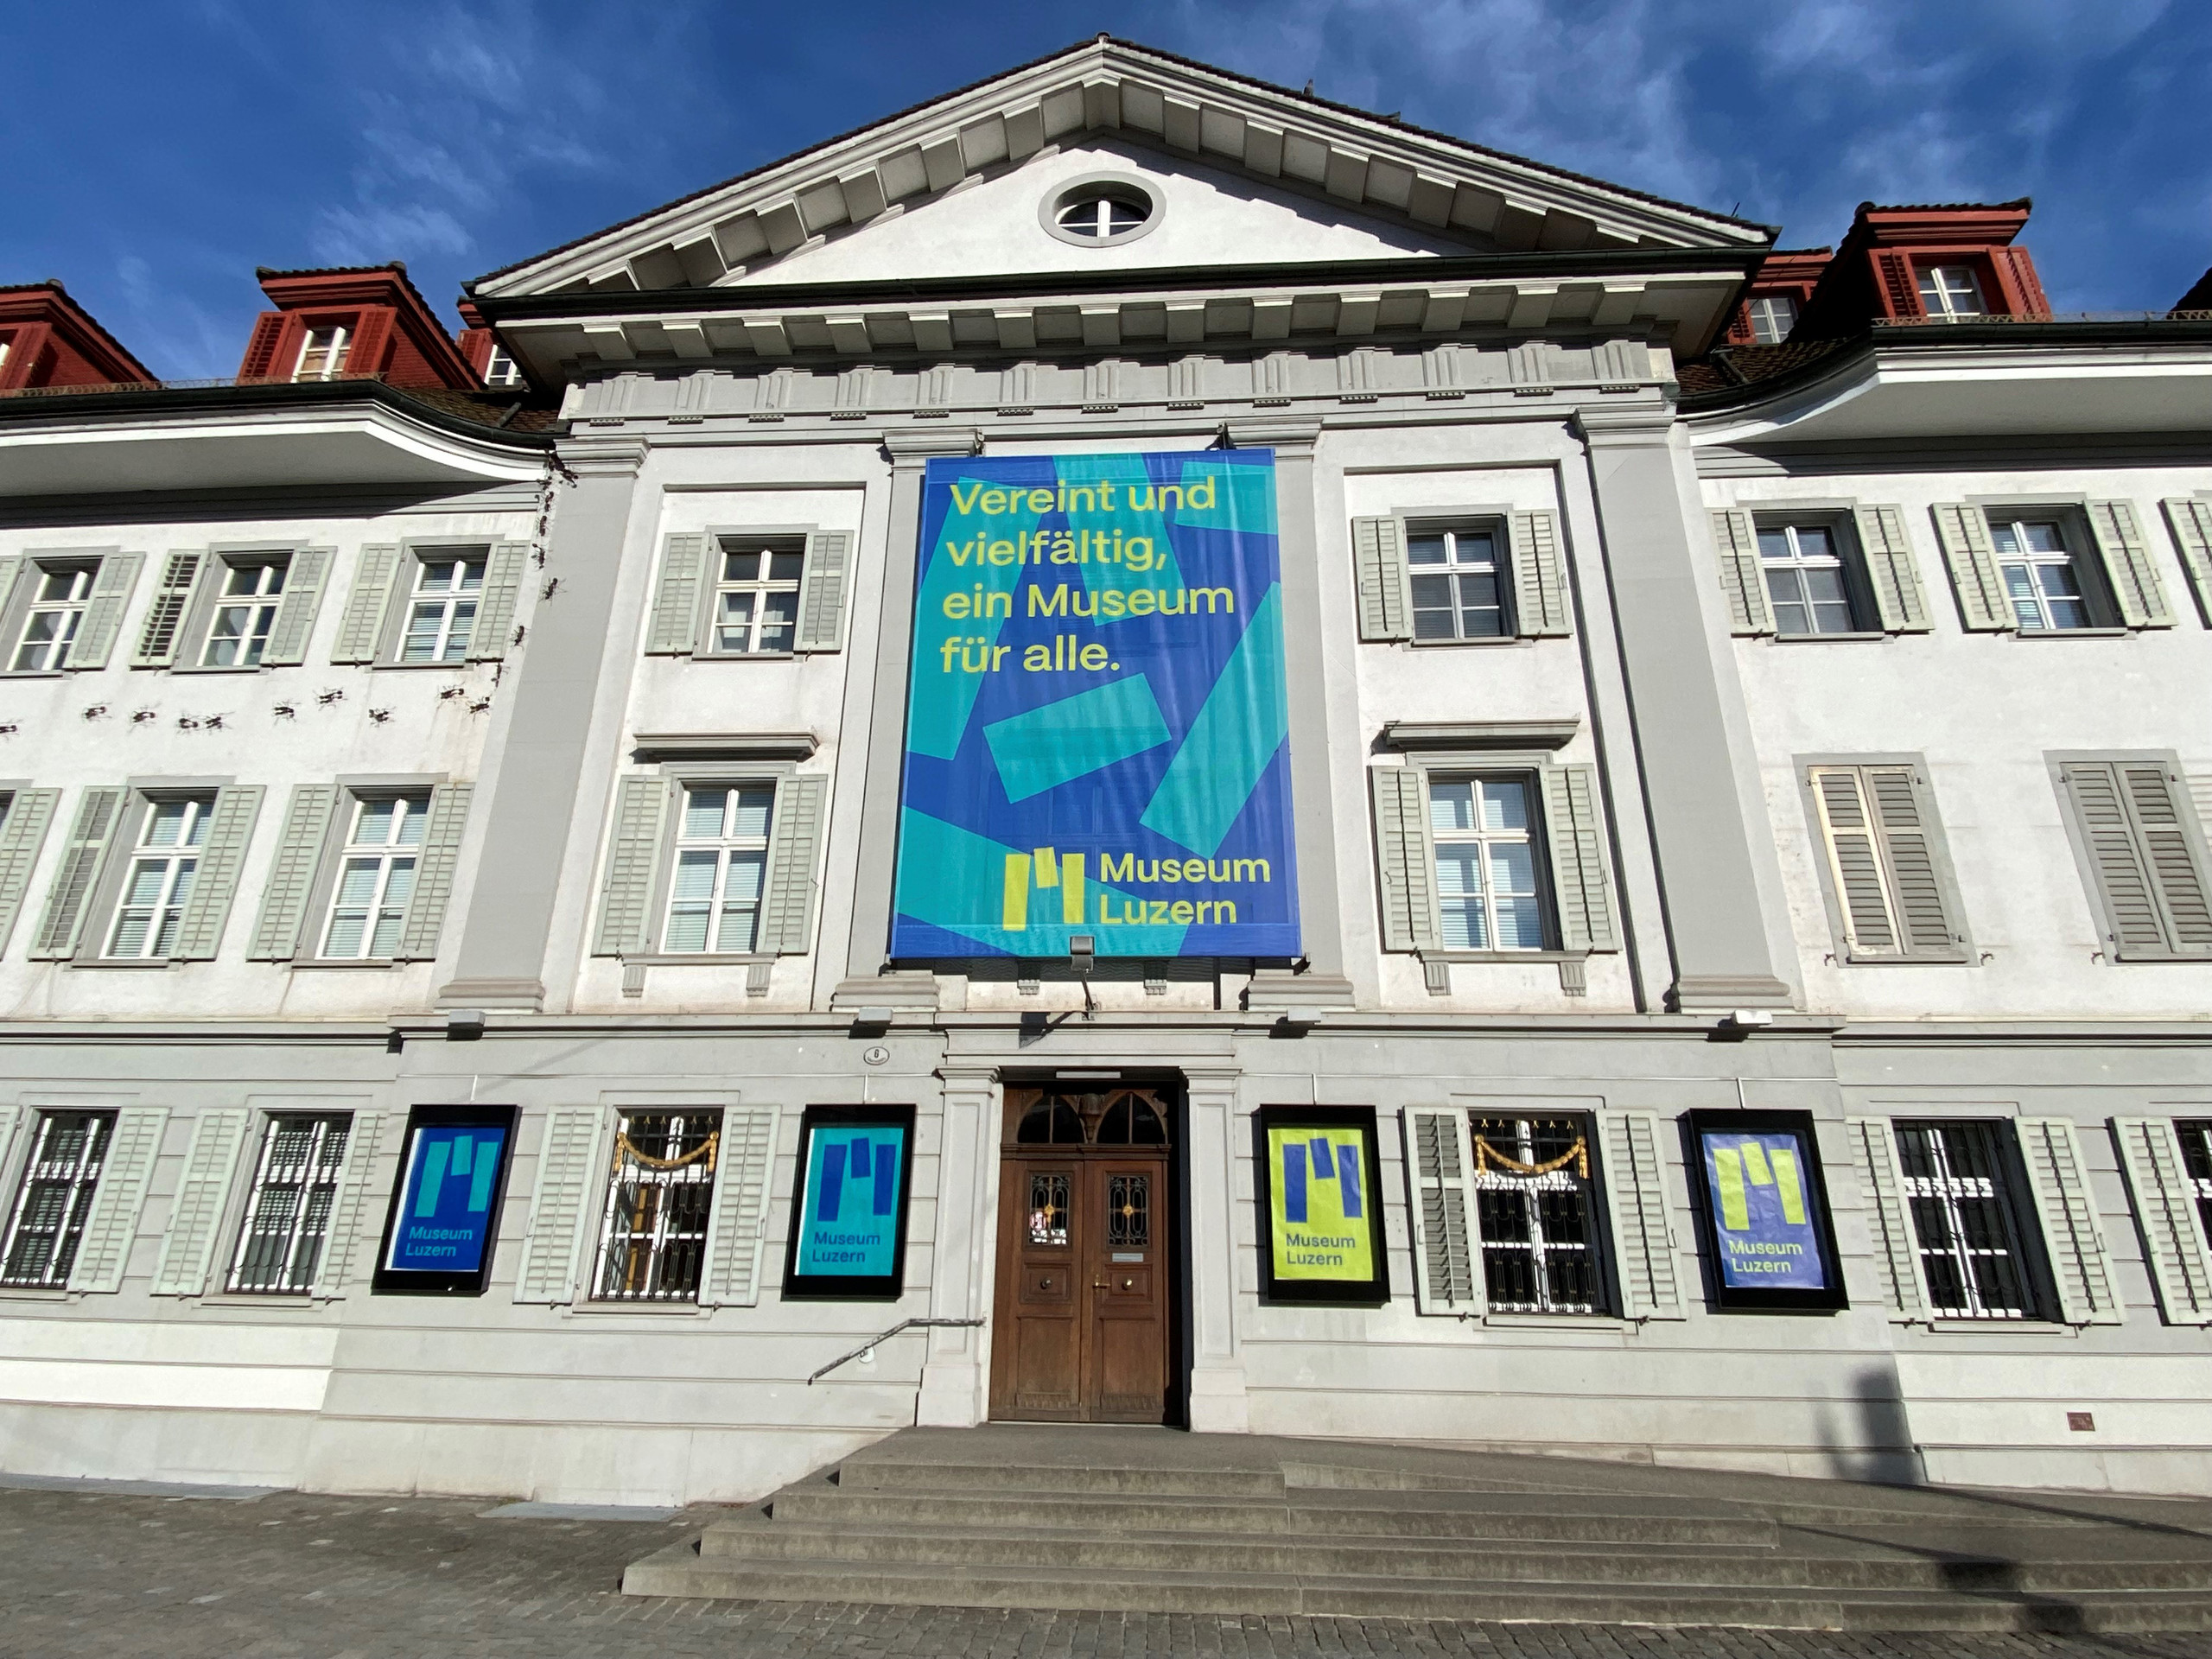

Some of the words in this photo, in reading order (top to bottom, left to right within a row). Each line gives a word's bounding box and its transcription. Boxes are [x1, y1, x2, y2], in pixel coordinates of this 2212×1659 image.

[950, 480, 1116, 515] Vereint
[1128, 476, 1215, 511] und
[947, 530, 1167, 571] vielfältig,
[943, 586, 1012, 620] ein
[1027, 584, 1234, 617] Museum
[940, 636, 1011, 673] für
[1023, 635, 1120, 671] alle.
[1101, 853, 1270, 882] Museum
[1100, 894, 1236, 925] Luzern
[409, 1226, 473, 1241] Museum
[814, 1231, 880, 1245] Museum
[1286, 1234, 1356, 1249] Museum
[405, 1243, 457, 1257] Luzern
[1728, 1239, 1802, 1255] Museum
[812, 1249, 866, 1262] Luzern
[1287, 1250, 1343, 1266] Luzern
[1732, 1258, 1792, 1274] Luzern
